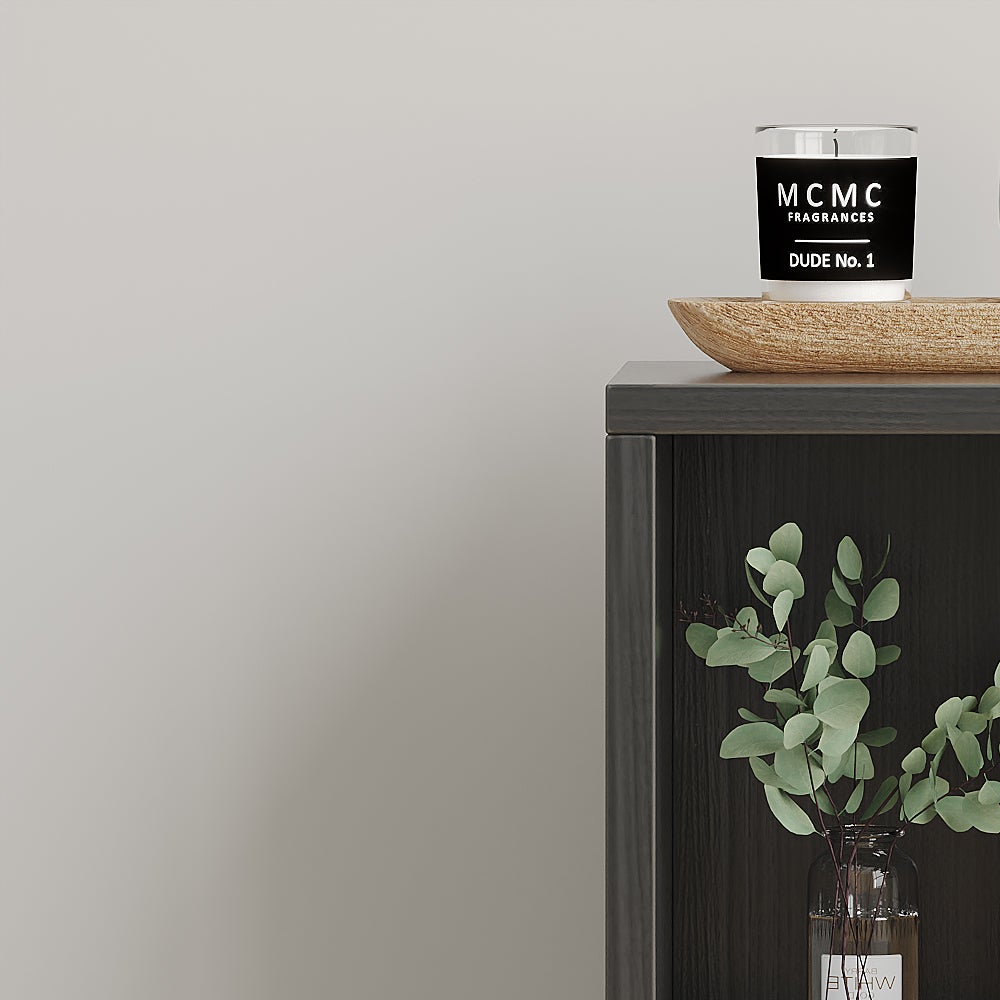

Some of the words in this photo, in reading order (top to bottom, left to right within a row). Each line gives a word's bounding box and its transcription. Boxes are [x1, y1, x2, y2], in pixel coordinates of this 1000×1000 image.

[777, 182, 882, 208] MCMC
[787, 211, 875, 223] FRAGRANCES
[789, 252, 831, 268] DUDE
[835, 252, 862, 268] No.
[866, 252, 875, 268] 1
